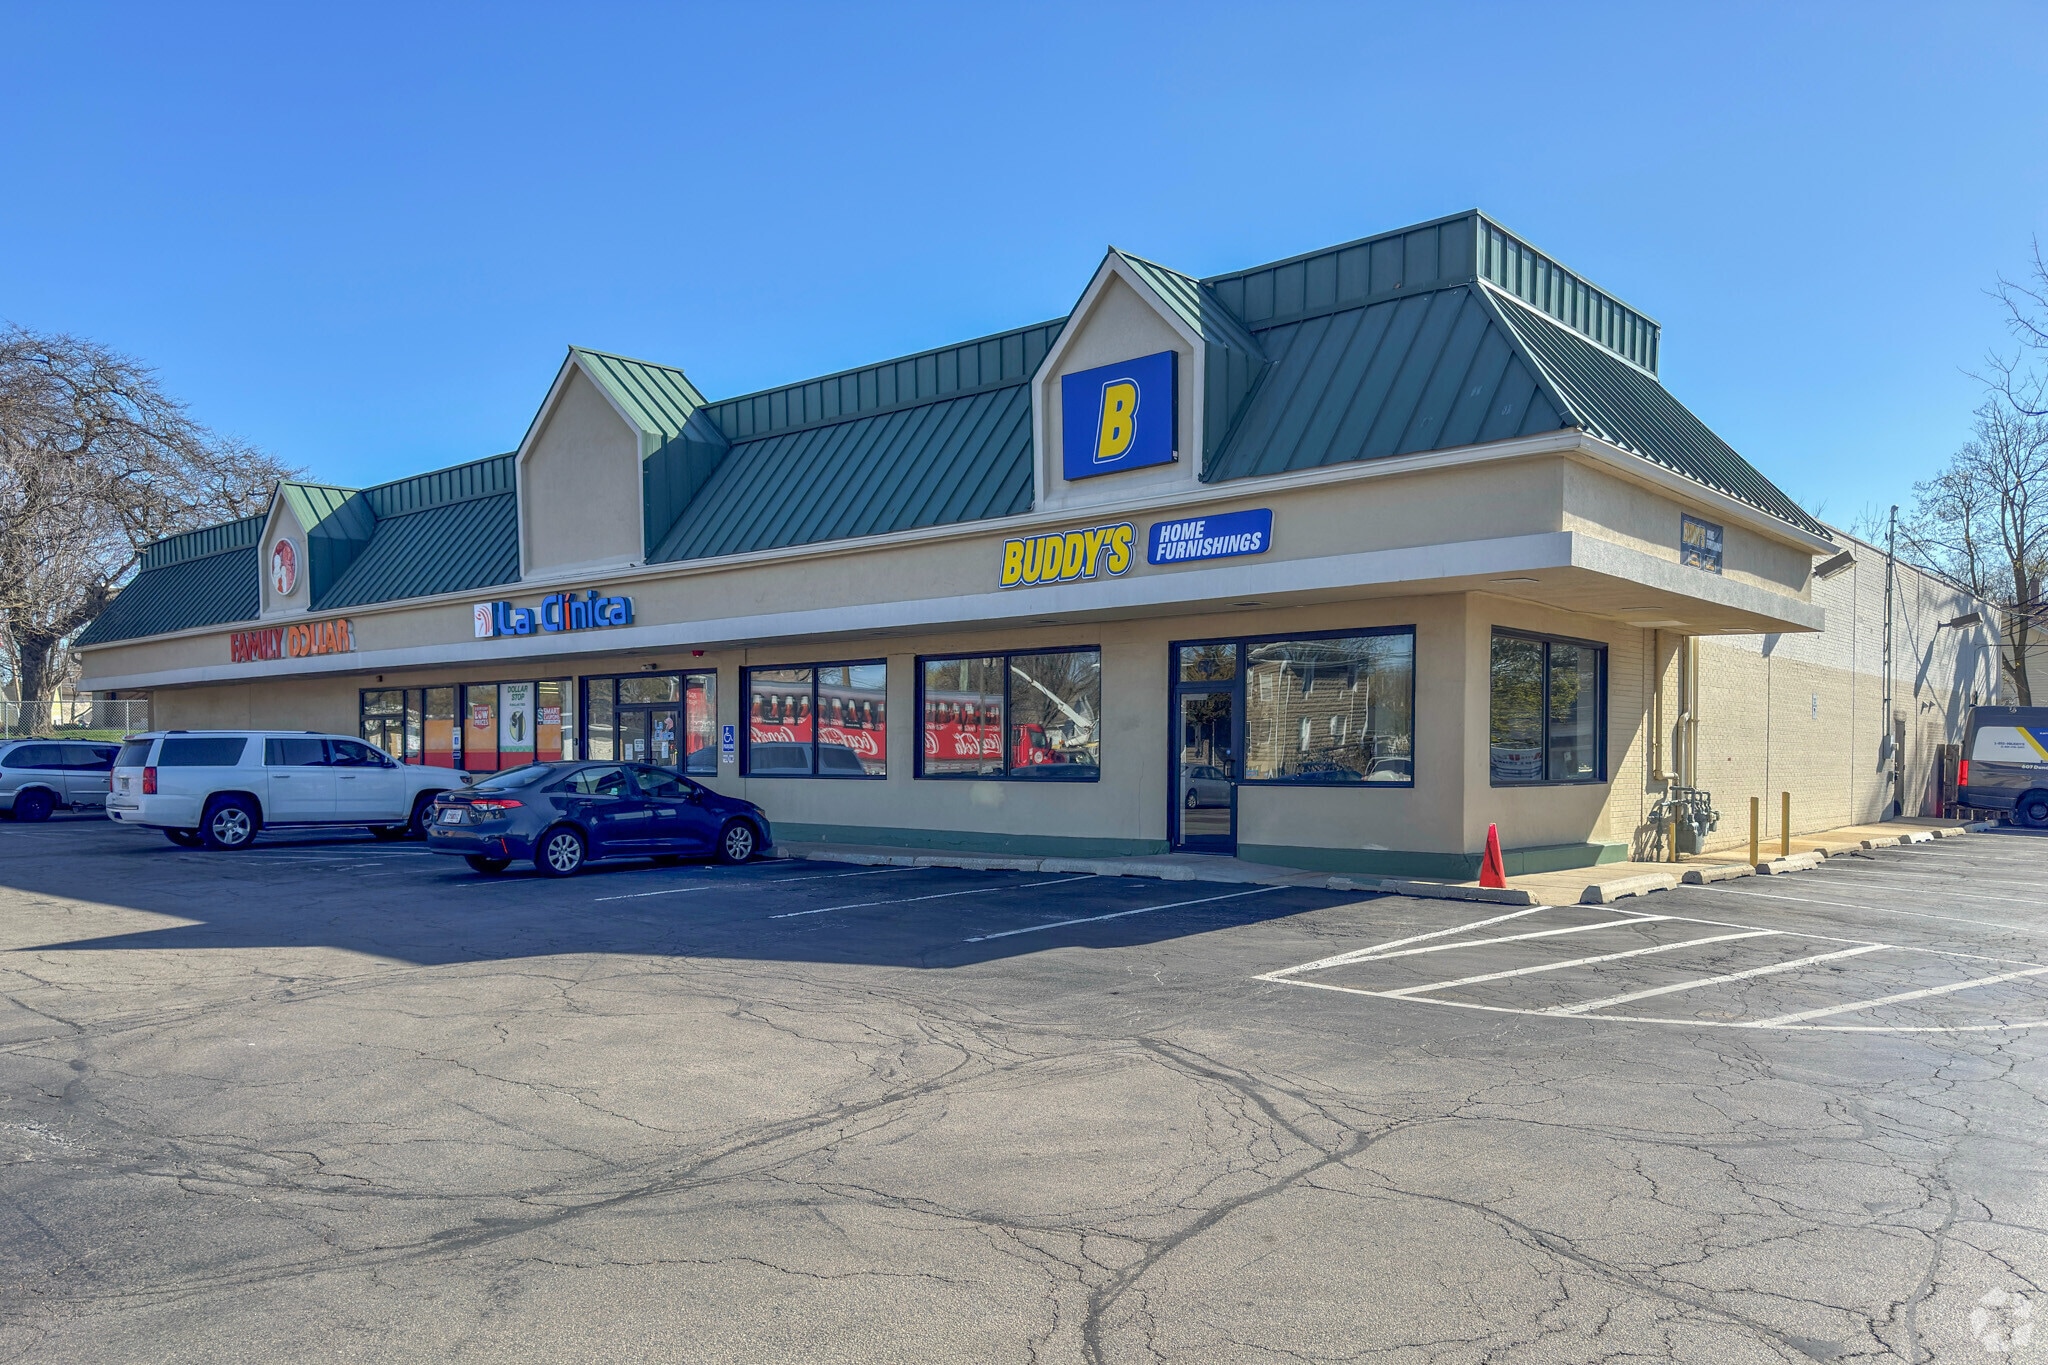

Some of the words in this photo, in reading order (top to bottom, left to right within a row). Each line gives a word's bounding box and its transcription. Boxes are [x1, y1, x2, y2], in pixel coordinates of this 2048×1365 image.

[1093, 378, 1140, 463] B
[1156, 532, 1262, 561] FURNISHINGS
[1159, 520, 1206, 543] HOME
[999, 523, 1137, 588] BUDDY'S
[499, 601, 532, 635] La
[230, 627, 284, 663] FAMILY
[287, 619, 351, 657] DOLLAR
[507, 685, 528, 693] DOLLAR
